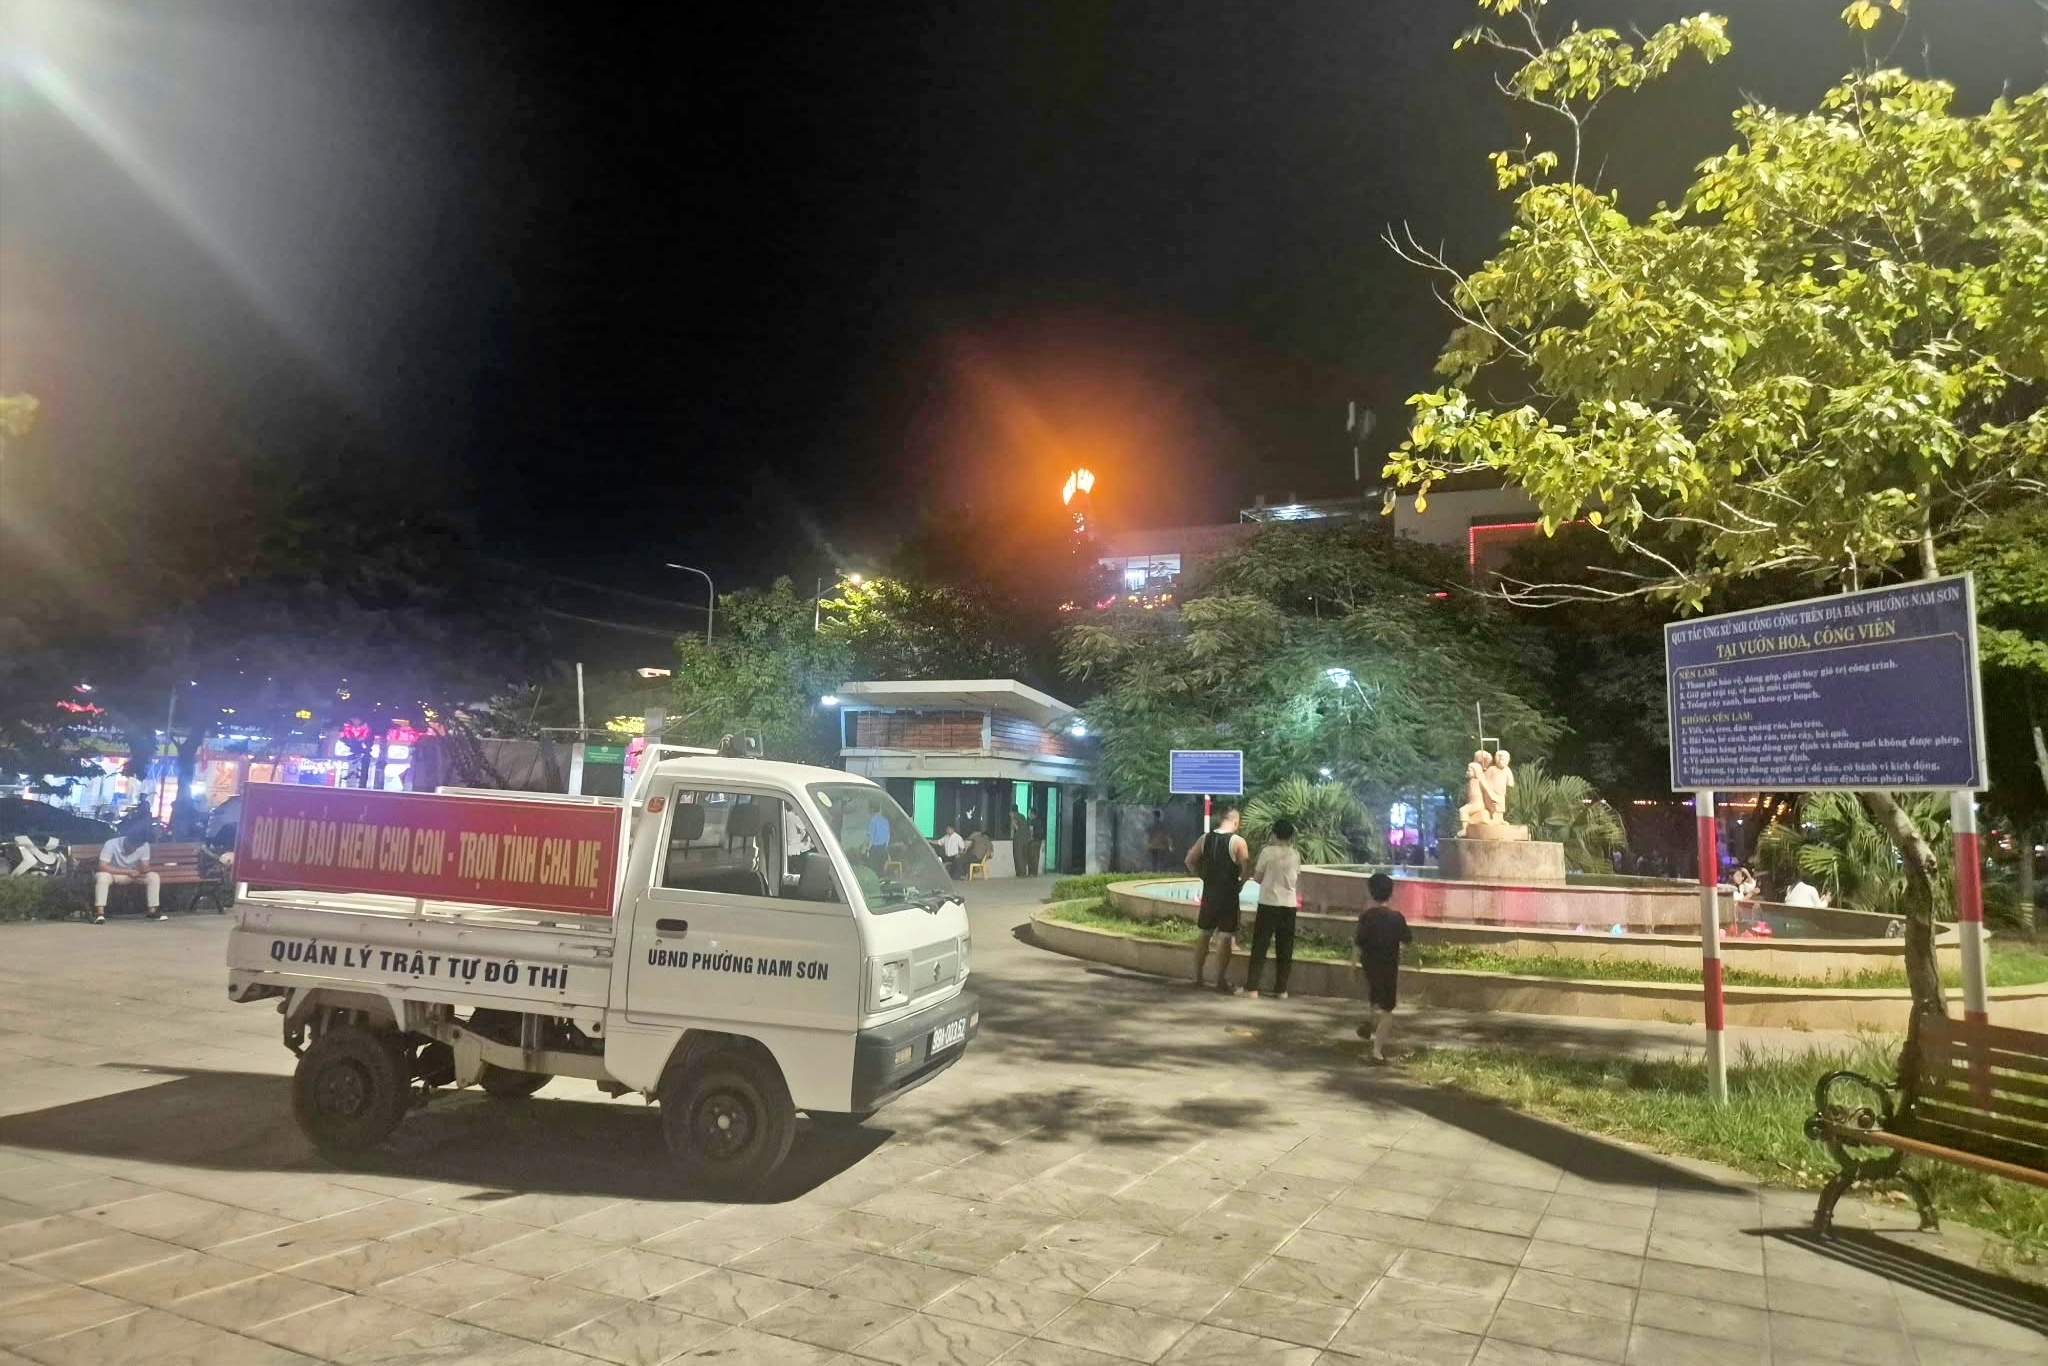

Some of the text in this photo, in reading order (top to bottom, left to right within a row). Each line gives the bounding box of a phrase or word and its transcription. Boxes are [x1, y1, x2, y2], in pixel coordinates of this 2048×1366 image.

[1672, 630, 1685, 645] QUY
[1687, 625, 1701, 640] TẮC
[1733, 622, 1747, 634] NƠI
[1748, 616, 1771, 632] CÔNG
[1774, 612, 1798, 630] CỘNG
[1800, 607, 1824, 624] TRÊN
[1826, 607, 1842, 622] ĐỊA
[1845, 604, 1864, 617] BÀN
[1867, 594, 1909, 613] PHƯỜNG
[1912, 591, 1935, 605] NAM
[1937, 586, 1960, 603] SƠN
[1717, 617, 1896, 660] TẠI VƯỜN HOA, CÔNG VIÊN
[252, 806, 602, 899] ĐỘI MŨ BẢO HIỂM CHO CON - TRỌN TÌNH CHA MẸ
[271, 938, 569, 995] QUẢN LÝ TRẬT TỰ ĐÔ THỊ
[648, 949, 829, 981] UBND PHƯỜNG NAM SƠN
